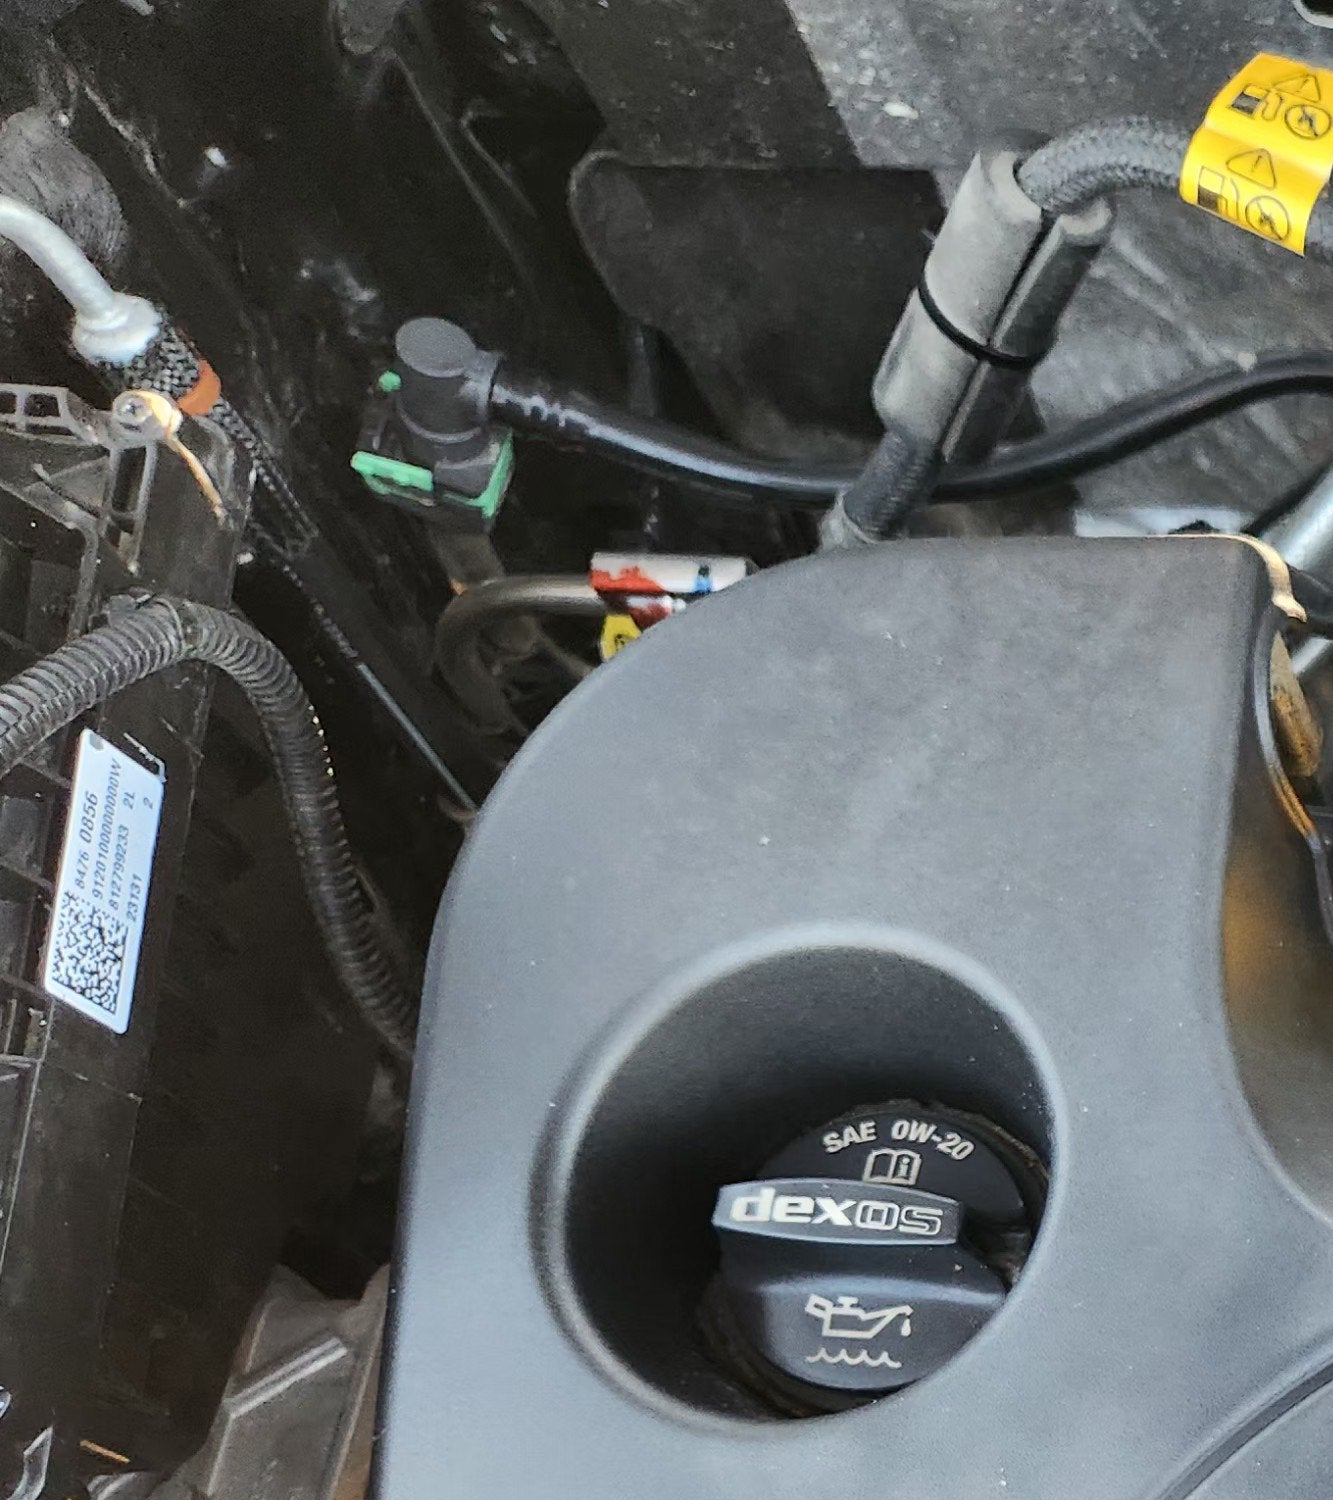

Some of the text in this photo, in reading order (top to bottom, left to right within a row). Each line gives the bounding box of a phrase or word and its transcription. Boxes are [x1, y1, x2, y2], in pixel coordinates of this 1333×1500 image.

[75, 790, 98, 889] 8476 0856
[109, 791, 136, 910] 812799233 2L
[126, 797, 153, 922] 23131 2
[822, 1119, 975, 1161] SAE 0W-20
[729, 1186, 944, 1236] dexos
